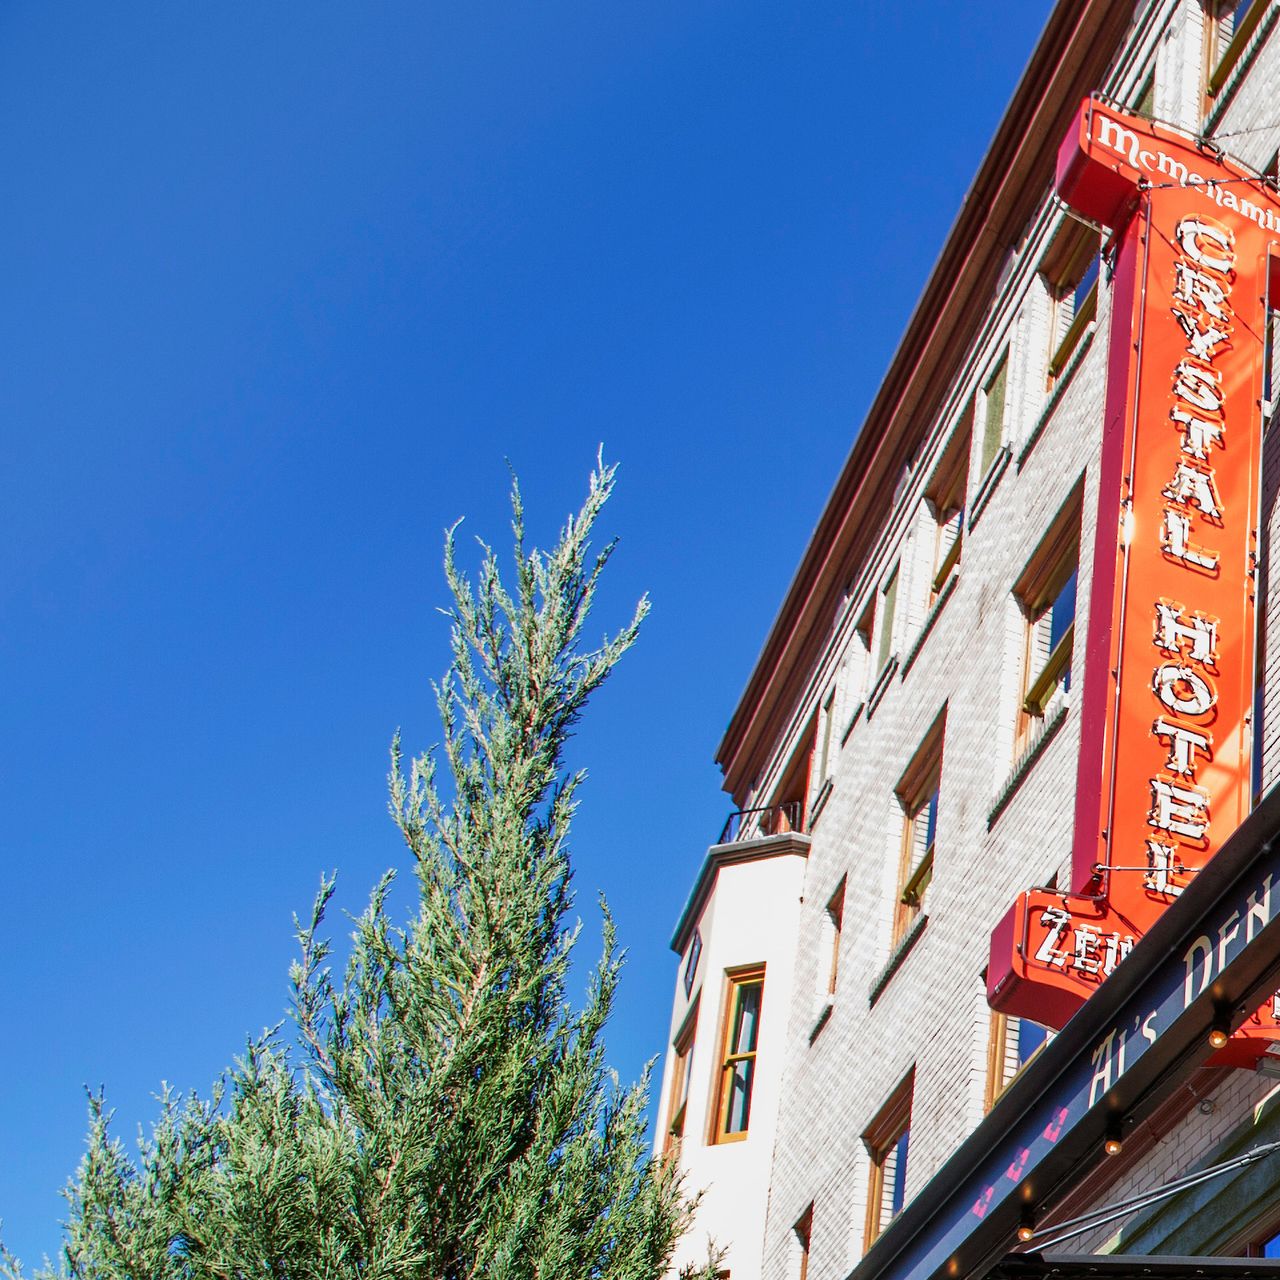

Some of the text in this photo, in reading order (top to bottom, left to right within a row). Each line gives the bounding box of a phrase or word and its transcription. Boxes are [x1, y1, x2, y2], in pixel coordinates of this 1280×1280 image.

[1160, 215, 1236, 575] CRYSTAL
[1143, 597, 1219, 897] HOTEL
[1034, 904, 1135, 978] ZEU
